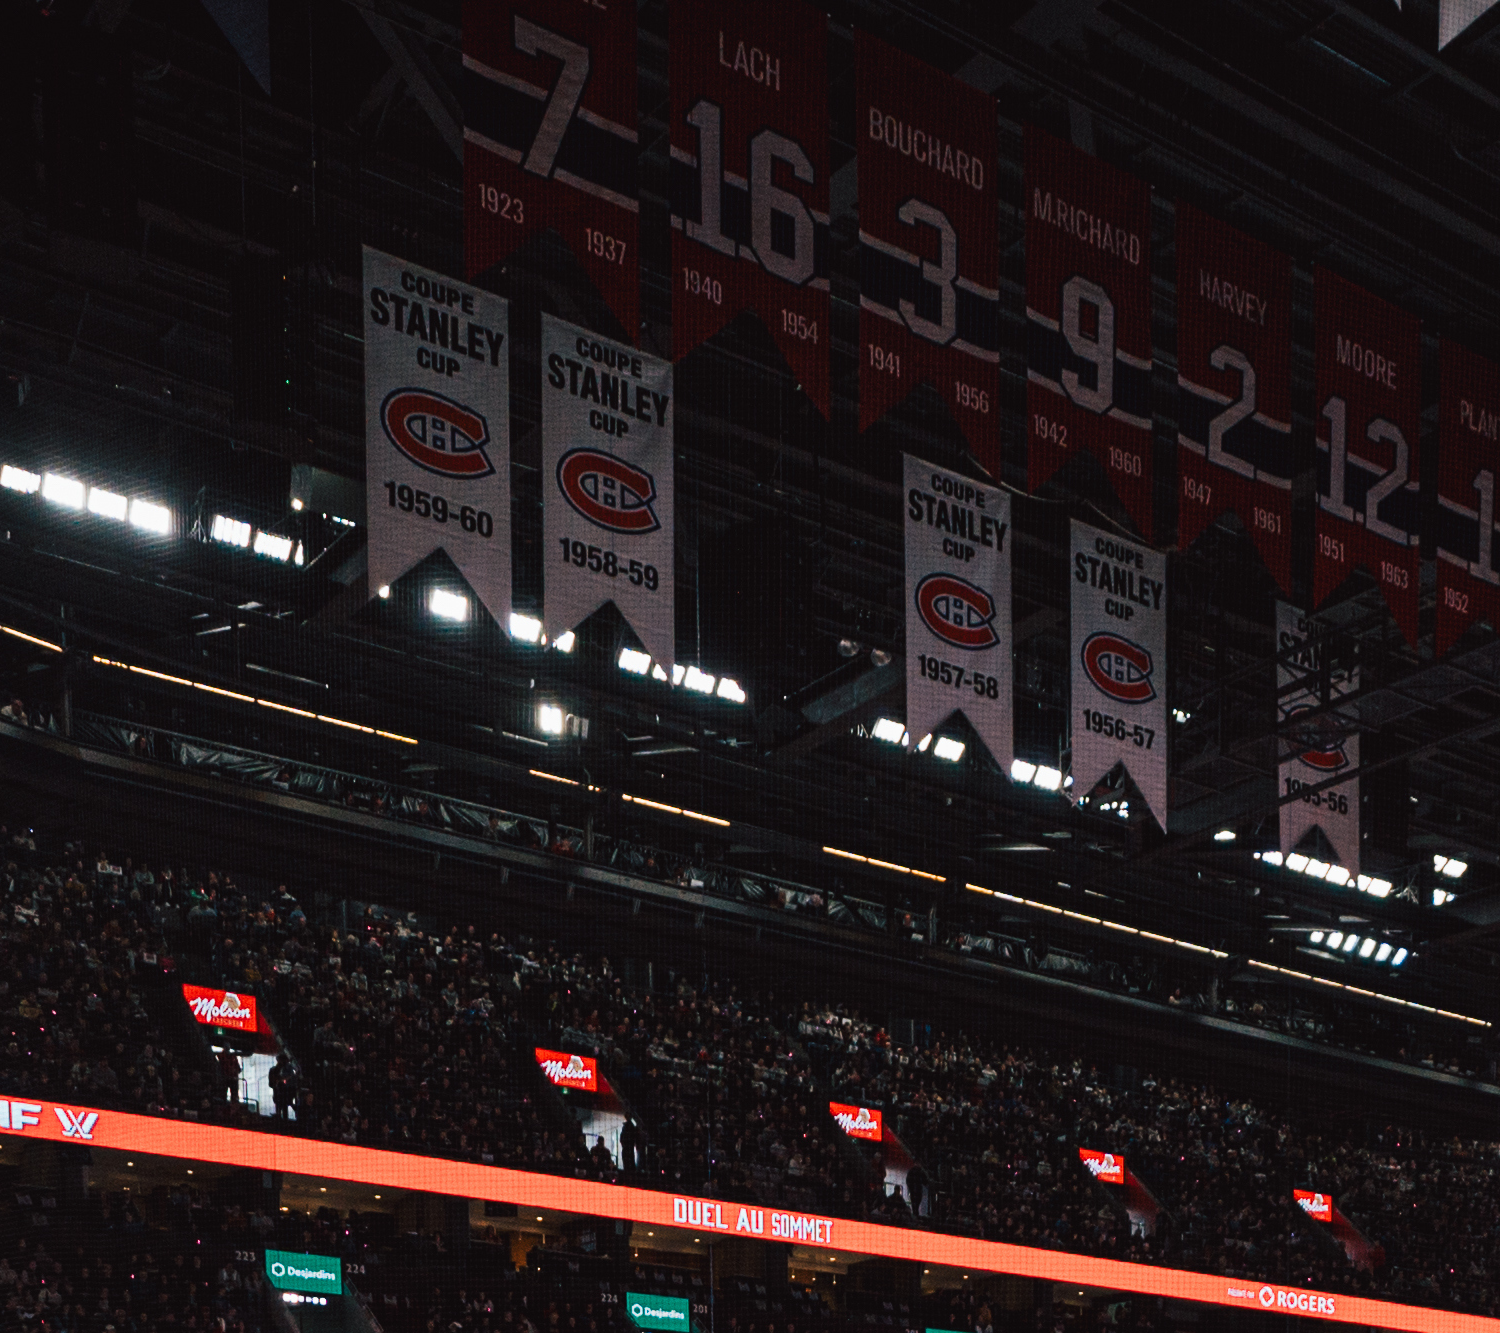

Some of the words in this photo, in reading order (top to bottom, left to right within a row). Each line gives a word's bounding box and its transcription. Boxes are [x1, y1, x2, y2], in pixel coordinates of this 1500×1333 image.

[719, 31, 781, 90] LACH
[514, 14, 590, 178] 7
[869, 106, 984, 190] BOUCHARD
[478, 183, 524, 223] 1923
[686, 99, 814, 285] 16
[585, 227, 627, 265] 1937
[1034, 188, 1141, 265] M.RICHARD
[681, 267, 722, 304] 1940
[898, 198, 958, 347] 3
[401, 271, 474, 315] COUPE
[1200, 269, 1268, 327] HARVEY
[371, 287, 504, 367] STANLEY
[781, 309, 818, 344] 1954
[1061, 275, 1114, 415] 9
[417, 346, 460, 378] CUP
[576, 337, 643, 379] COUPE
[868, 343, 900, 377] 1941
[1336, 333, 1397, 390] MOORE
[548, 353, 670, 427] STANLEY
[955, 381, 989, 413] 1956
[589, 409, 629, 438] CUP
[1034, 414, 1068, 448] 1942
[1208, 345, 1256, 480] 2
[1109, 446, 1142, 476] 1960
[1319, 396, 1413, 546] 12
[384, 481, 493, 537] 1959-60
[931, 474, 985, 508] COUPE
[1183, 475, 1211, 505] 1947
[909, 489, 1007, 552] STANLEY
[1253, 506, 1282, 535] 1961
[559, 537, 659, 590] 1958-59
[943, 538, 975, 562] CUP
[1096, 538, 1143, 570] COUPE
[1319, 533, 1345, 562] 1951
[1076, 553, 1163, 610] STANLEY
[1105, 599, 1134, 621] CUP
[918, 654, 998, 699] 1957-58
[1083, 709, 1155, 750] 1956-57
[189, 997, 251, 1021] Molson
[541, 1059, 592, 1083] Molson
[674, 1198, 728, 1230] DUEL
[736, 1207, 764, 1234] AU
[772, 1212, 833, 1244] SOMMET
[288, 1265, 335, 1281] Desjardins
[644, 1306, 685, 1320] Desjardins
[1277, 1290, 1335, 1314] ROGERS
